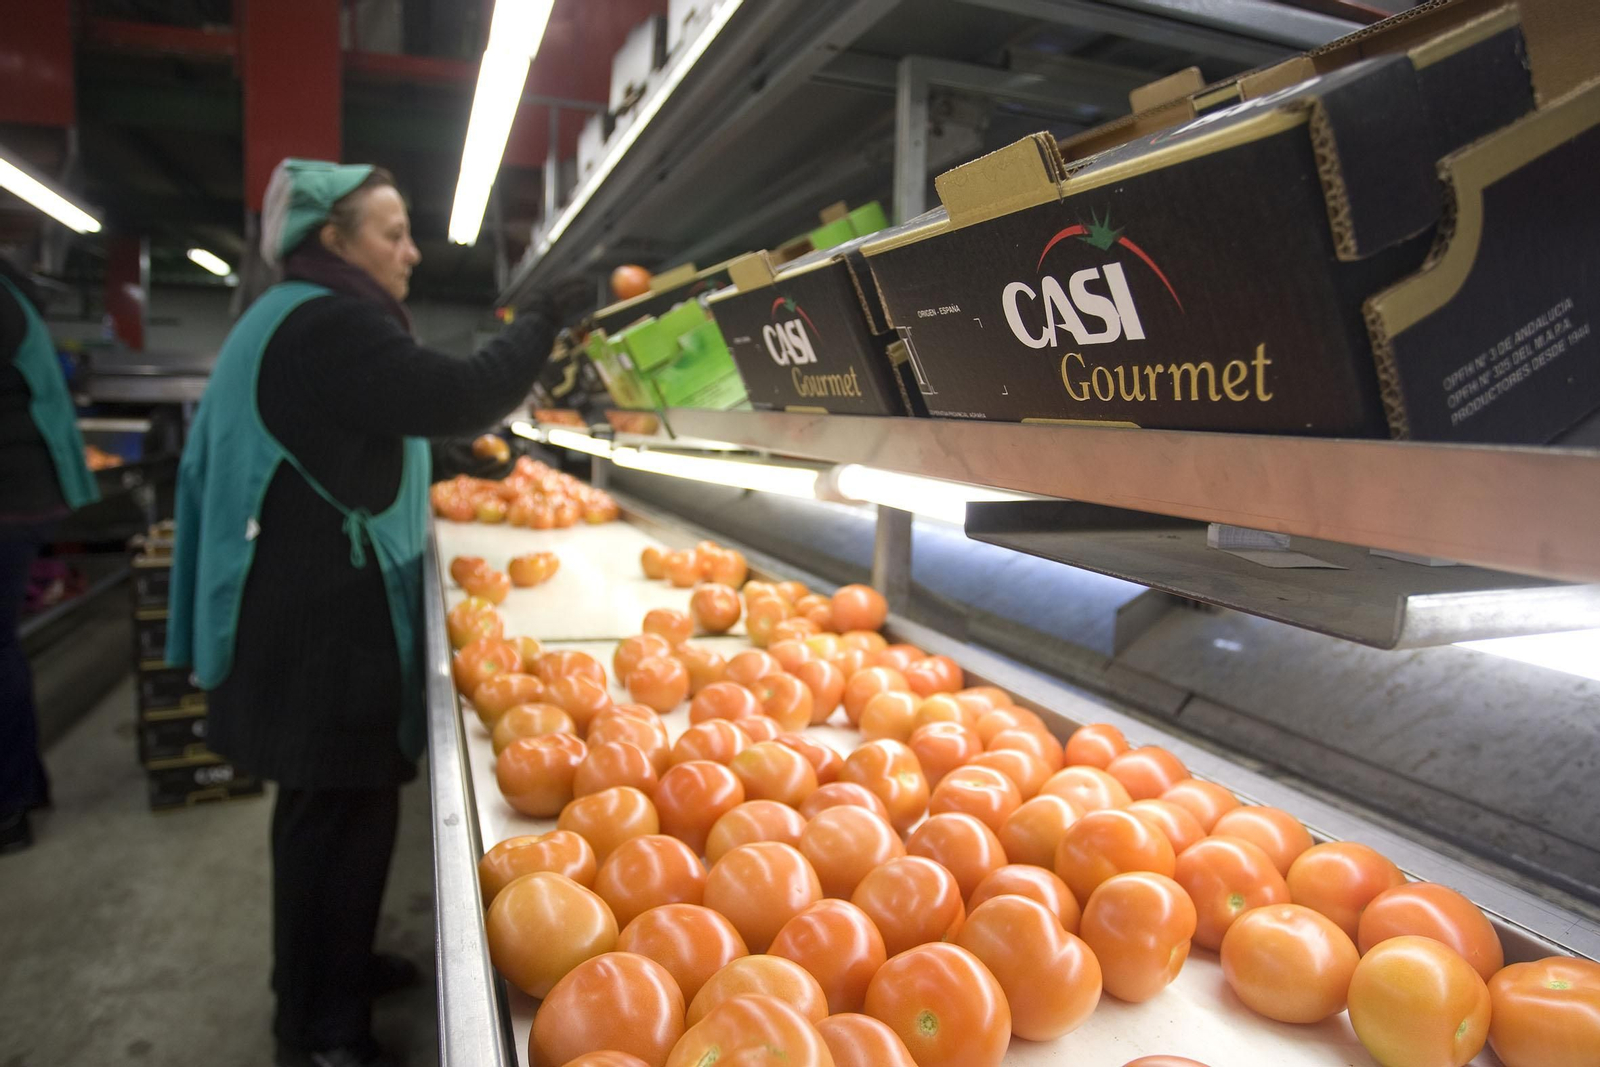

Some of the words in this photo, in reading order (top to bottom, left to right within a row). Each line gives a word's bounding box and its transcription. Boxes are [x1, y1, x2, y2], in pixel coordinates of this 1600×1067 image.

[917, 309, 937, 318] ORIGEN
[938, 303, 961, 315] ESPAÑA
[1002, 262, 1146, 349] CASI
[763, 319, 817, 366] CASI
[1488, 348, 1497, 361] 3
[1498, 336, 1512, 356] DE
[1512, 344, 1533, 365] DEL
[791, 366, 862, 397] Gourmet
[1061, 343, 1273, 402] Gourmet
[1450, 363, 1531, 426] PRODUCTORES
[1531, 339, 1566, 371] DESDE
